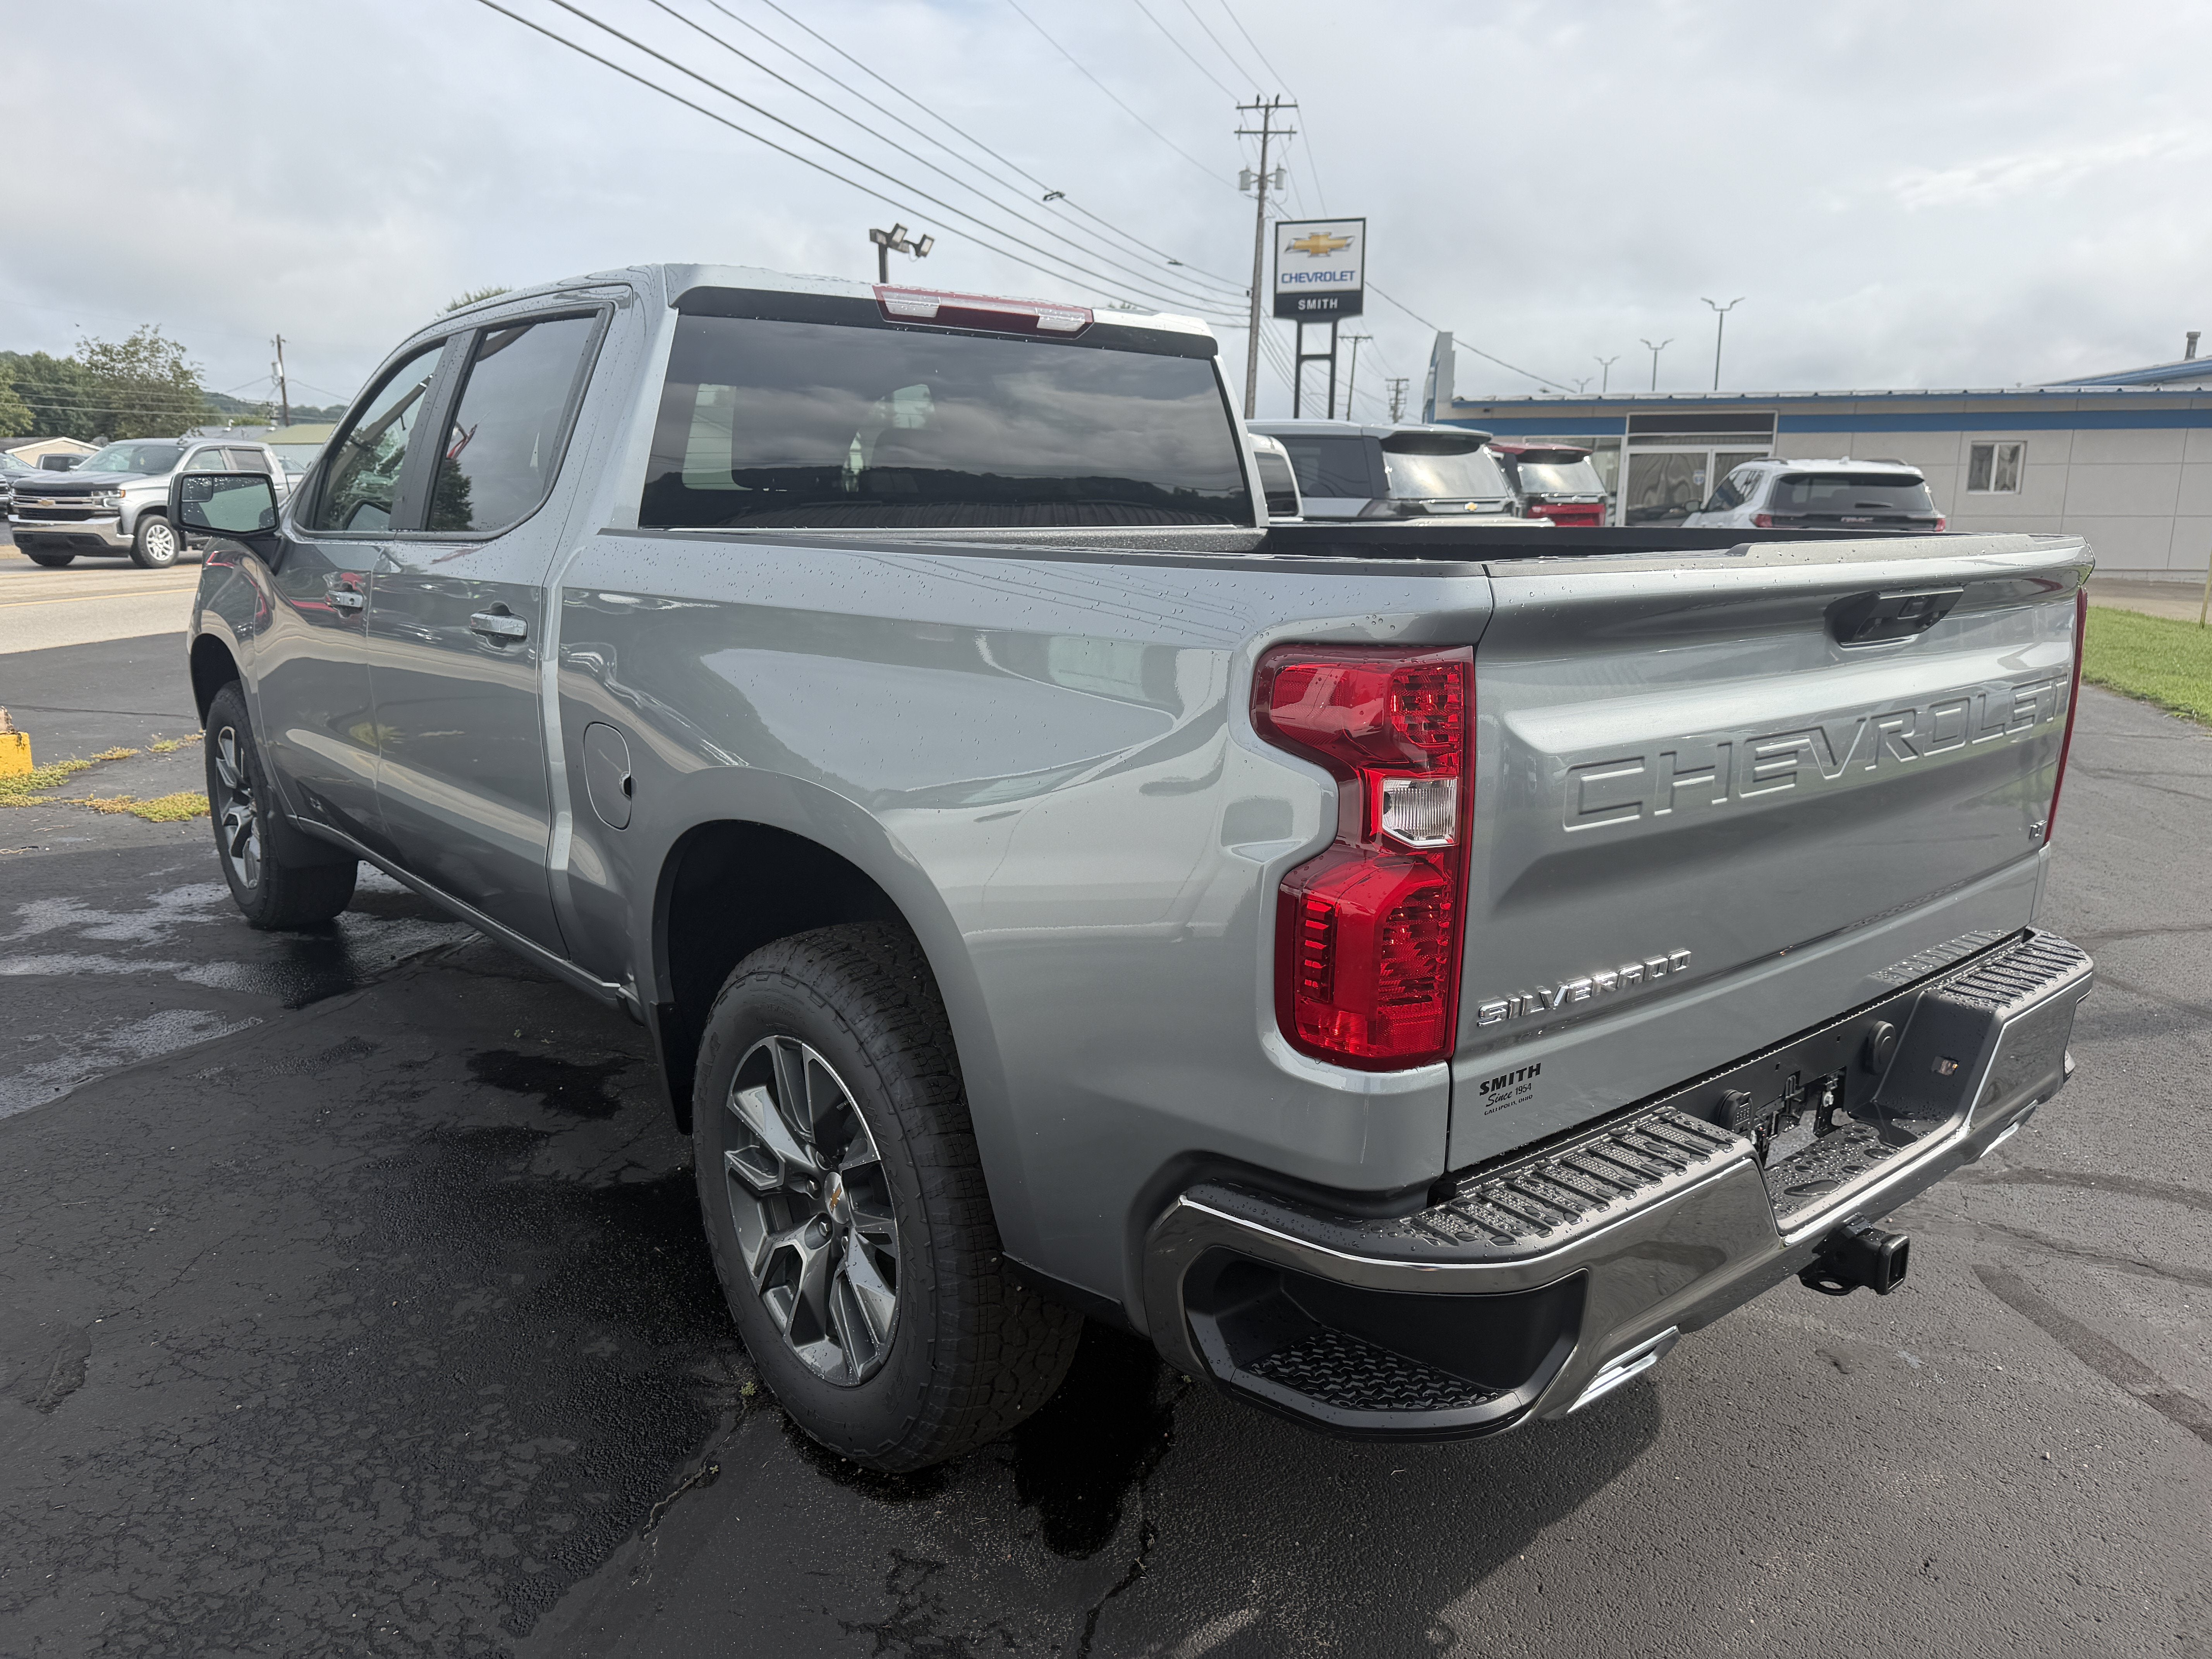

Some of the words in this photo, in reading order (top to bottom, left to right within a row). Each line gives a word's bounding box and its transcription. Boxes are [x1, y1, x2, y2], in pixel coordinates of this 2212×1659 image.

[1281, 270, 1355, 284] CHEVROLET
[1298, 298, 1338, 310] SMITH
[1562, 674, 2068, 833] CHEVROLET
[1477, 949, 1692, 1027] SILVERADO
[1479, 1062, 1541, 1096] SMITH
[1486, 1091, 1513, 1108] Since
[1515, 1083, 1532, 1096] 1954
[1518, 1094, 1533, 1103] OHIO
